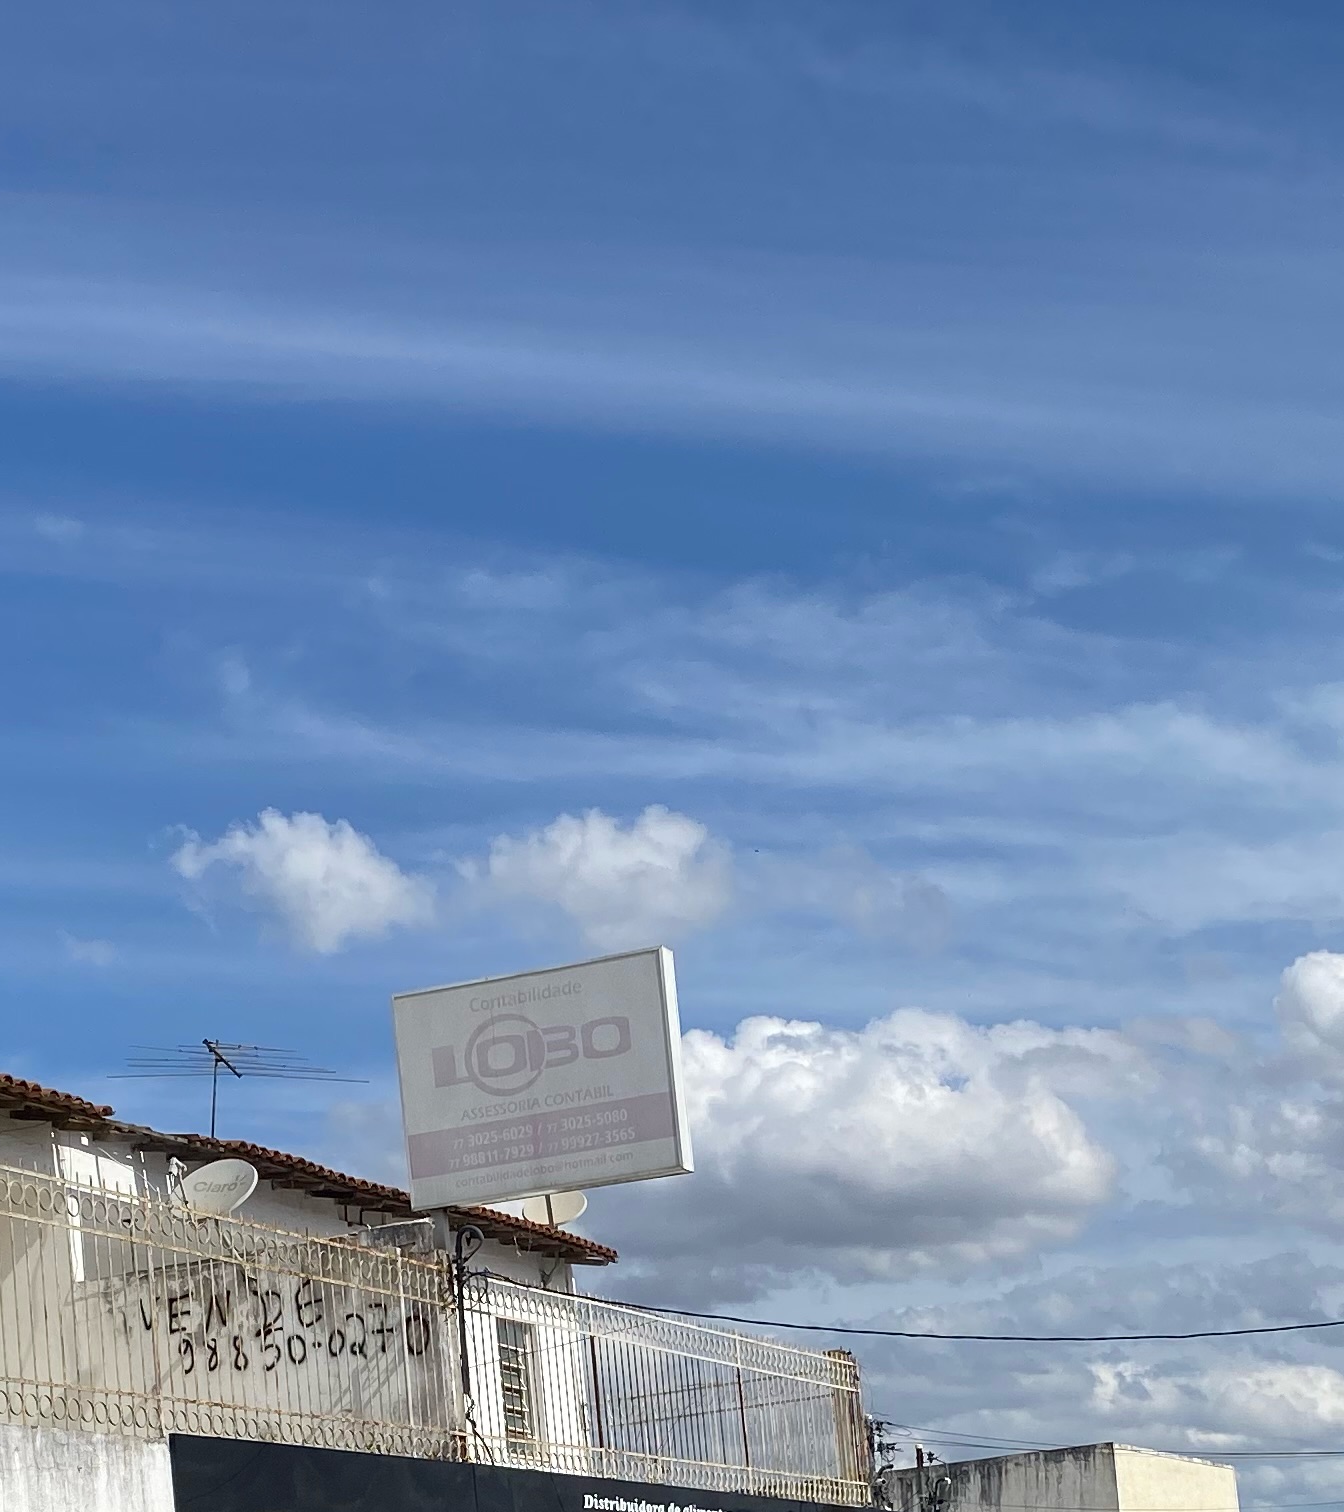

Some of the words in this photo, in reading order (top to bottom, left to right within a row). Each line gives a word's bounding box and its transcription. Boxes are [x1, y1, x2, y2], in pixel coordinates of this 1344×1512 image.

[469, 980, 582, 1013] Contabilidade
[431, 1015, 632, 1090] LOBO
[460, 1097, 541, 1121] ASSESSORIA
[544, 1085, 614, 1108] CONTABIL
[468, 1124, 533, 1147] 3025-6029
[561, 1108, 628, 1131] 3025-5080
[462, 1144, 534, 1167] 98811-7929
[194, 1181, 238, 1193] Claro
